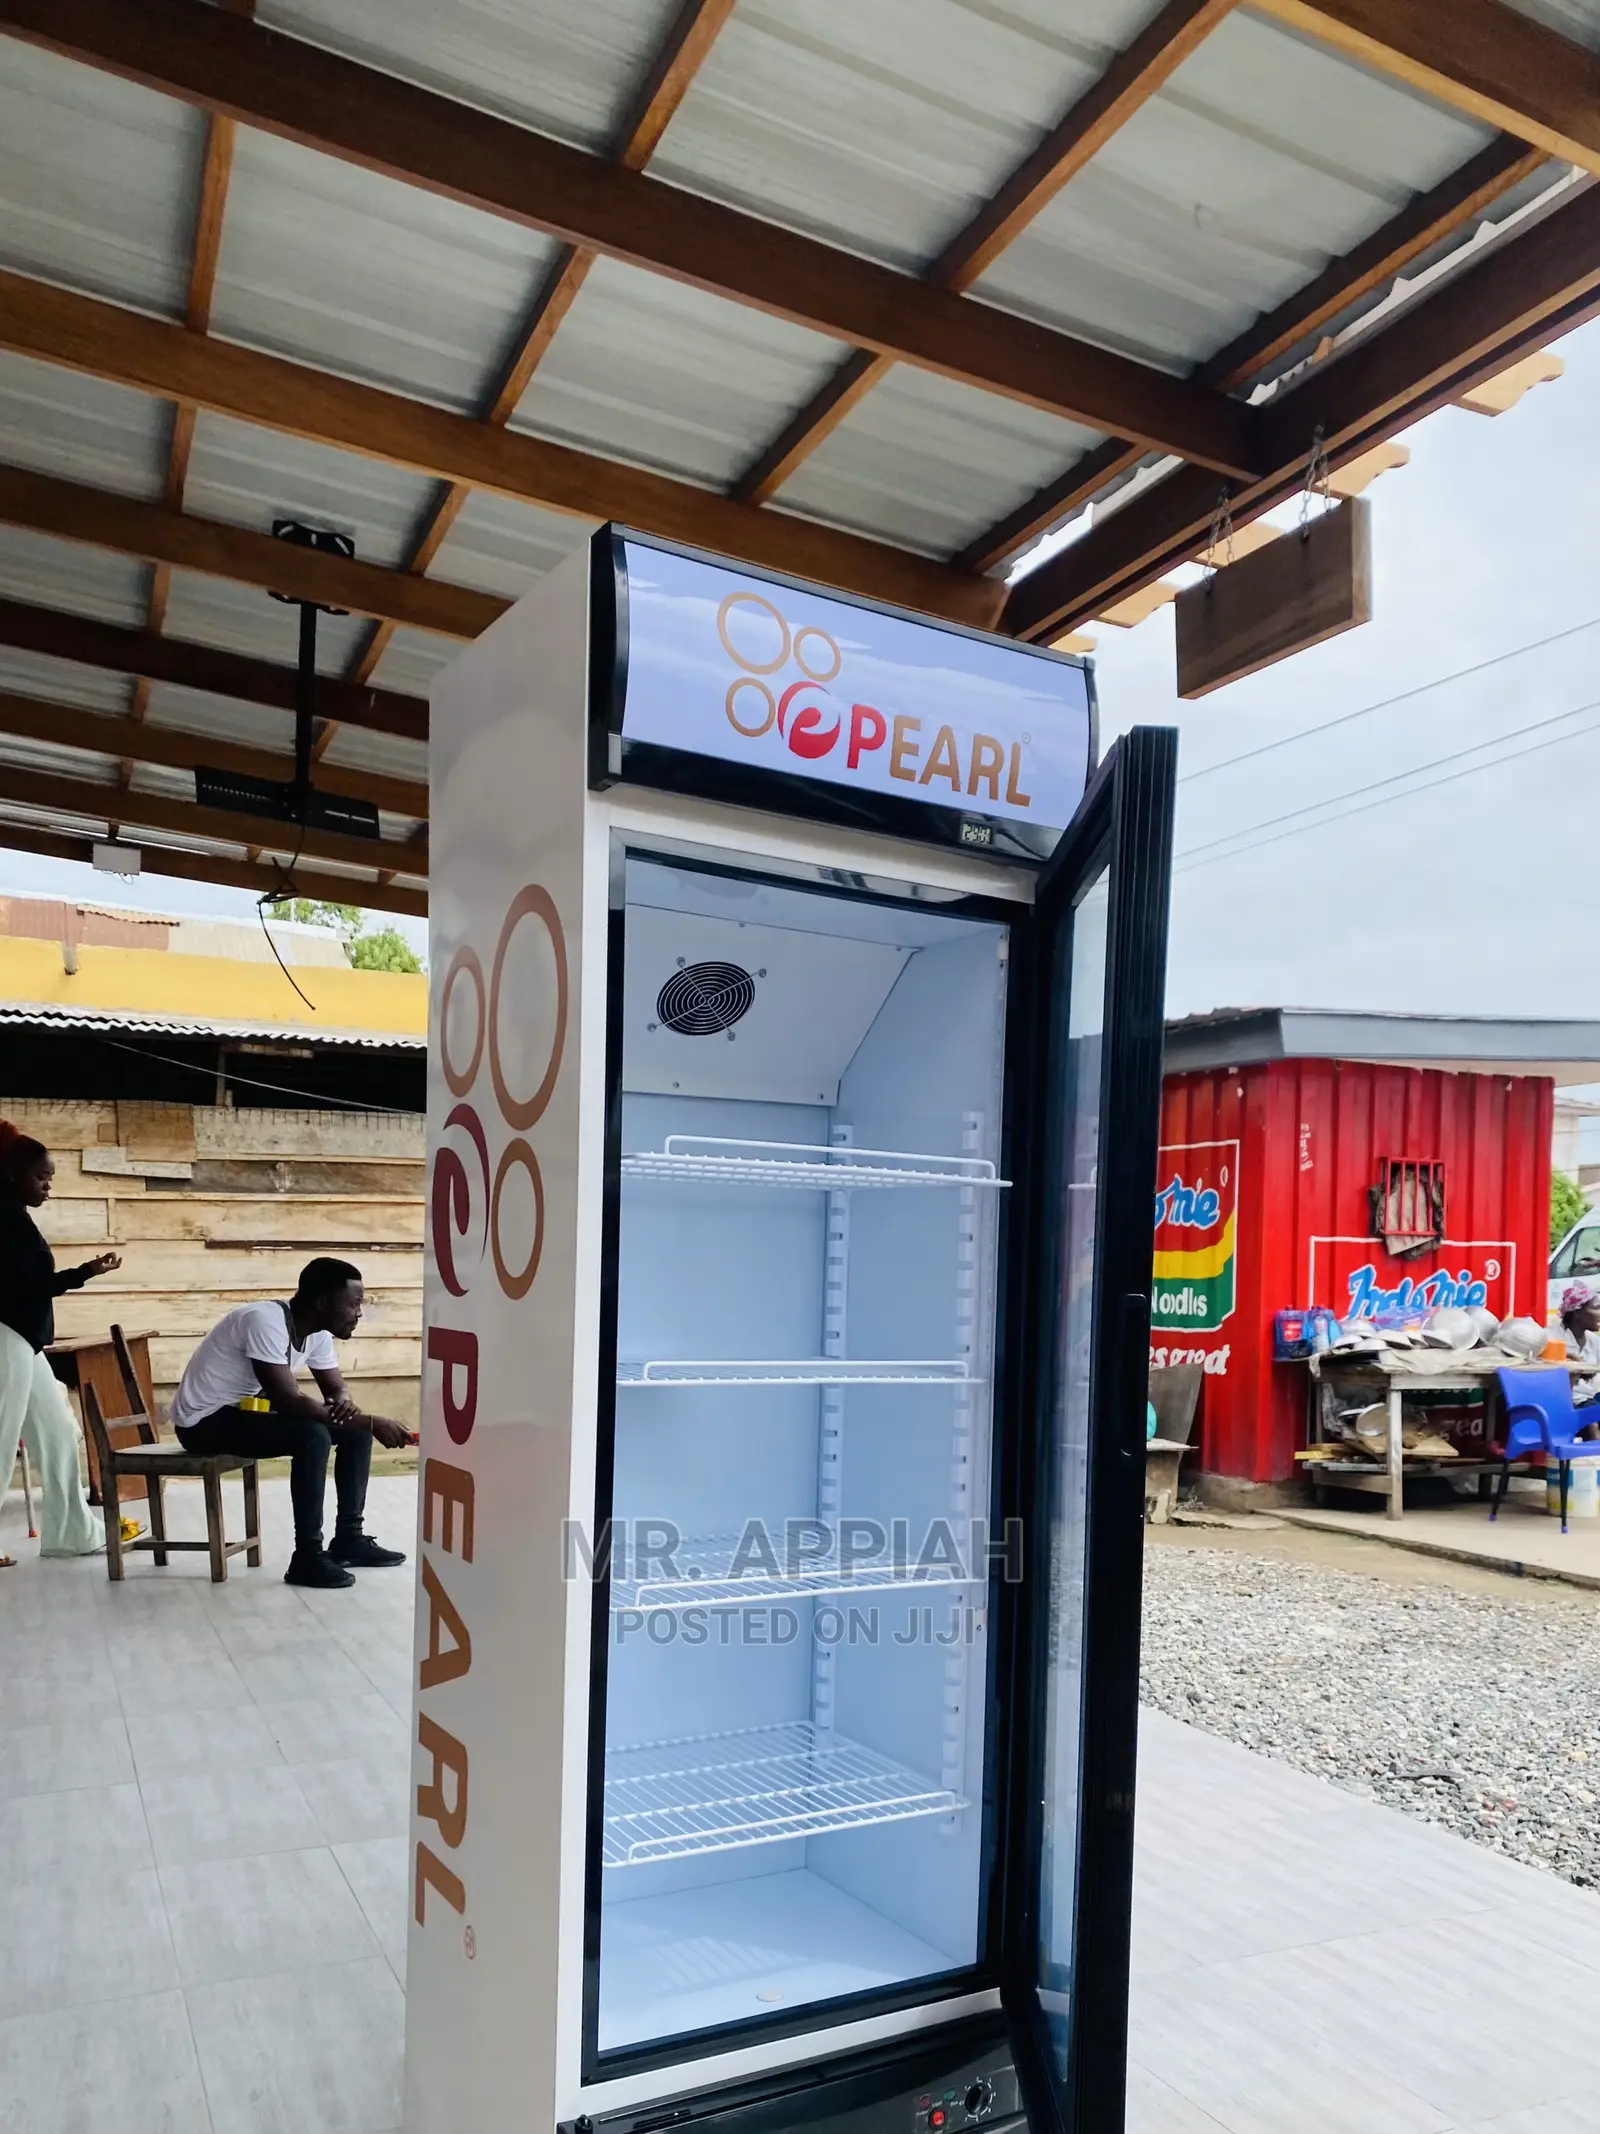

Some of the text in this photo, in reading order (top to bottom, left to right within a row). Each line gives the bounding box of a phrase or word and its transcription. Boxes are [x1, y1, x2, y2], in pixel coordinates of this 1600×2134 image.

[846, 702, 1032, 807] PEARL
[1154, 1173, 1221, 1231] omie
[415, 1326, 478, 1928] PEARL
